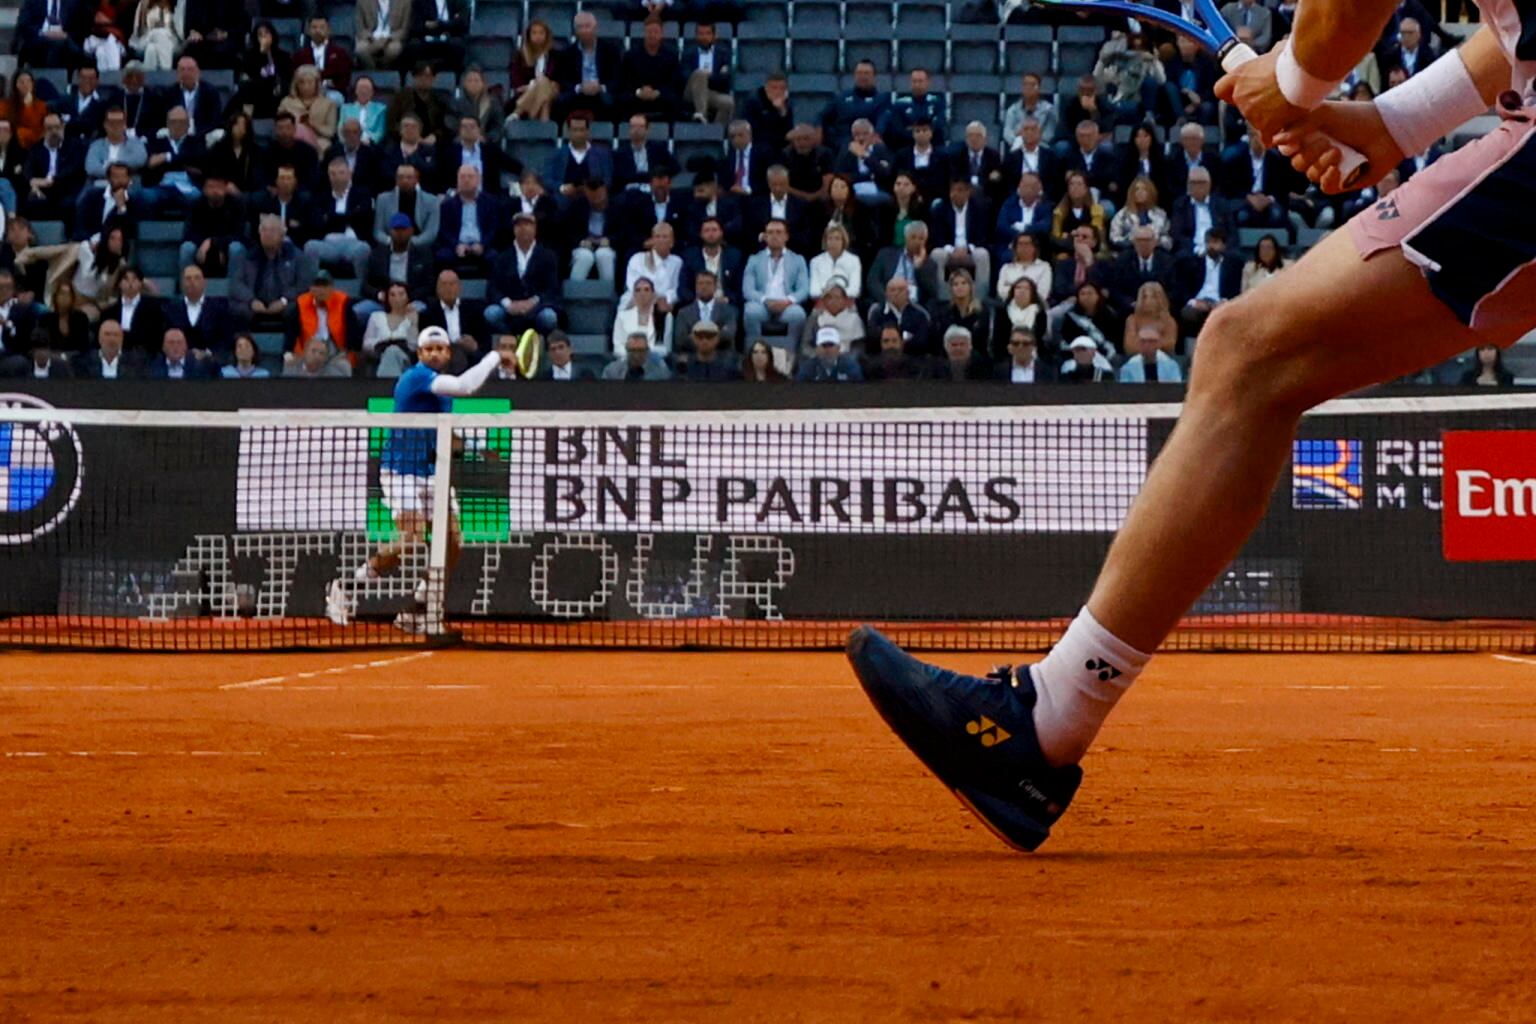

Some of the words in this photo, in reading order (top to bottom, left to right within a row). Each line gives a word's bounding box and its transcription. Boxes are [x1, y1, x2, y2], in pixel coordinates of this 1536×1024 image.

[545, 426, 687, 467] BNL
[1376, 440, 1443, 476] RE
[545, 475, 692, 523] BNP
[717, 475, 1021, 524] PARIBAS
[456, 531, 796, 621] TOUR
